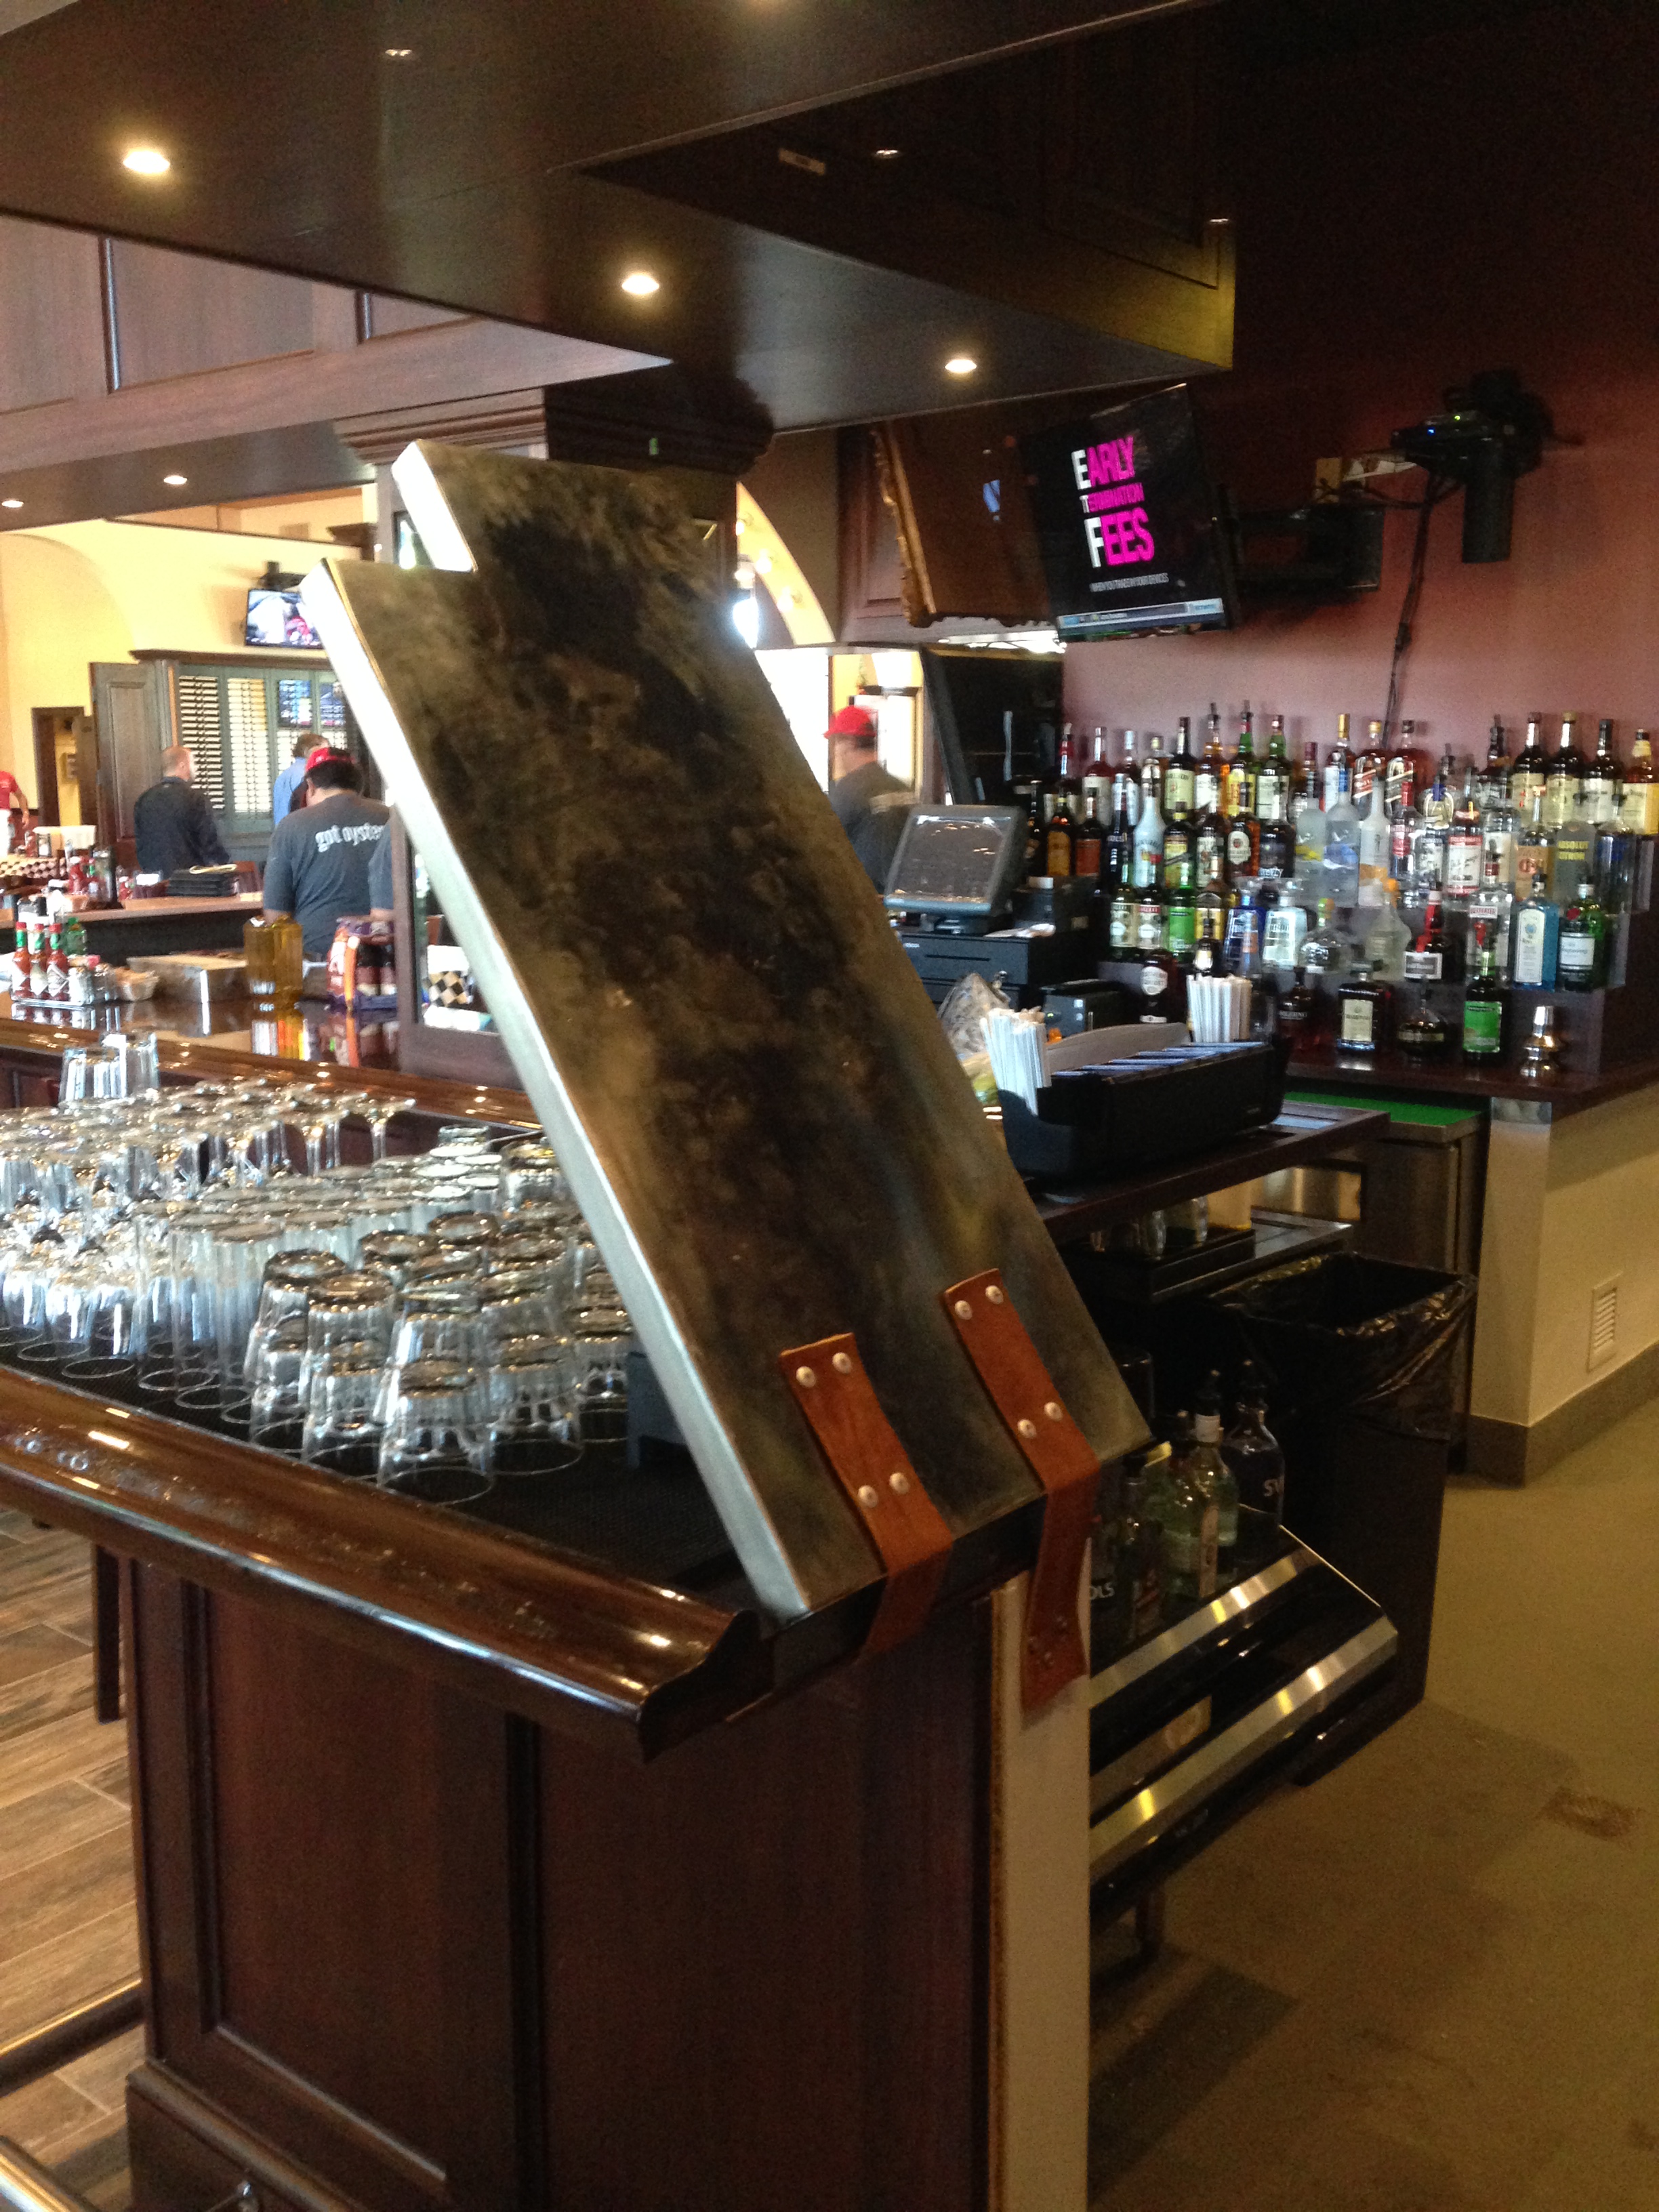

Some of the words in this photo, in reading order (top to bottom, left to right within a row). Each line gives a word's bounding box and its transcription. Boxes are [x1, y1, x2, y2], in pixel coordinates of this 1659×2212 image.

[1071, 435, 1136, 490] EARLY
[1084, 507, 1155, 568] FEES
[315, 825, 343, 853] got
